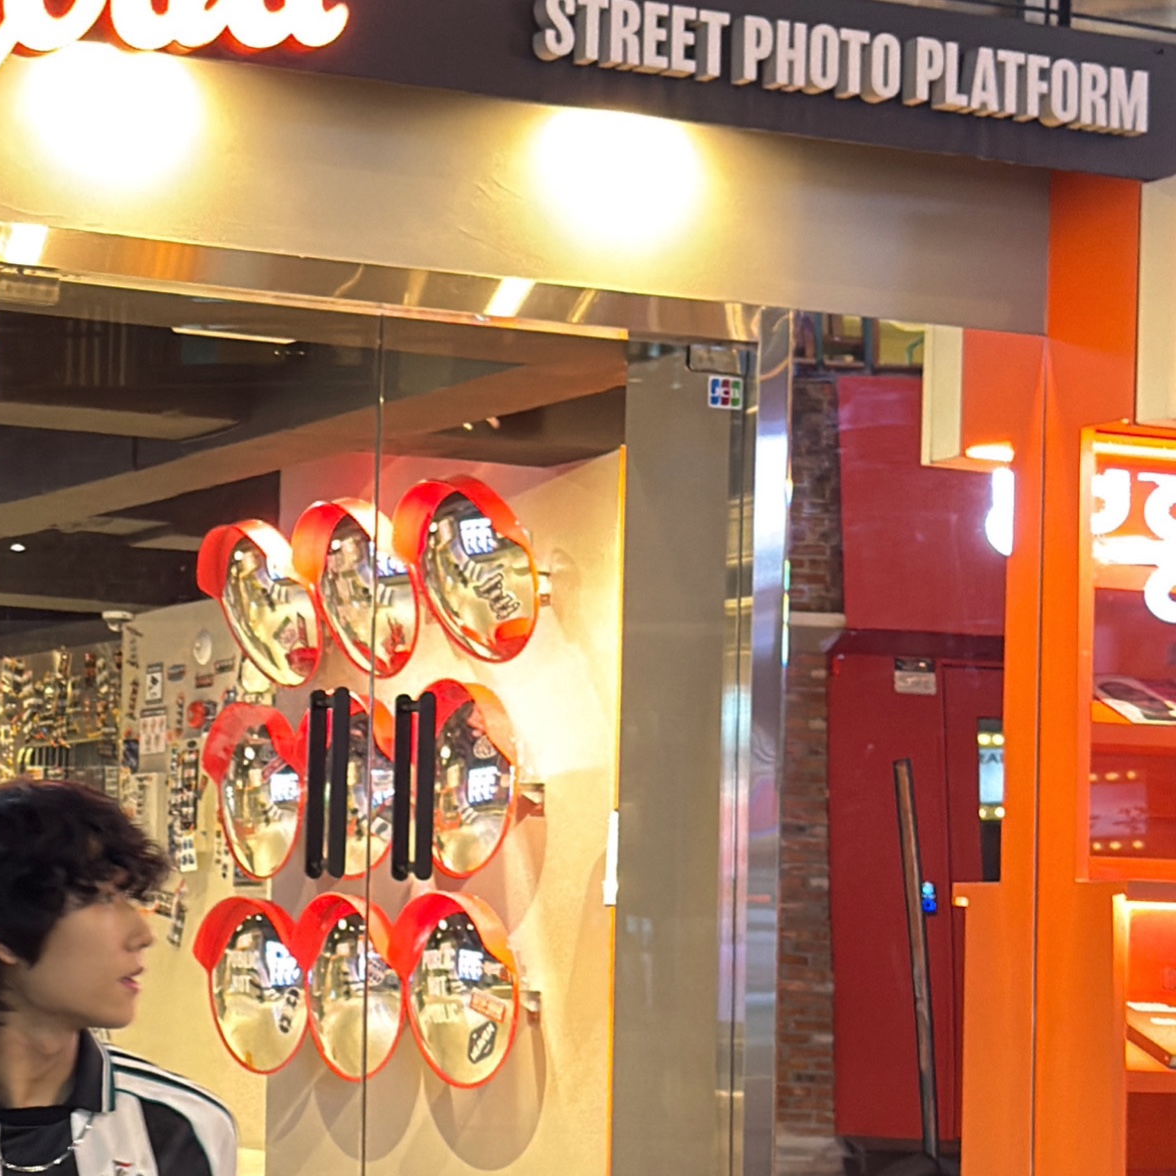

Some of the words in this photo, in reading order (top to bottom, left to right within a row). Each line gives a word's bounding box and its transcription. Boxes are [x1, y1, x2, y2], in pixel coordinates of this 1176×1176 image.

[536, 0, 730, 81] STREET
[733, 15, 901, 102] PHOTO
[906, 37, 1149, 136] PLATFORM
